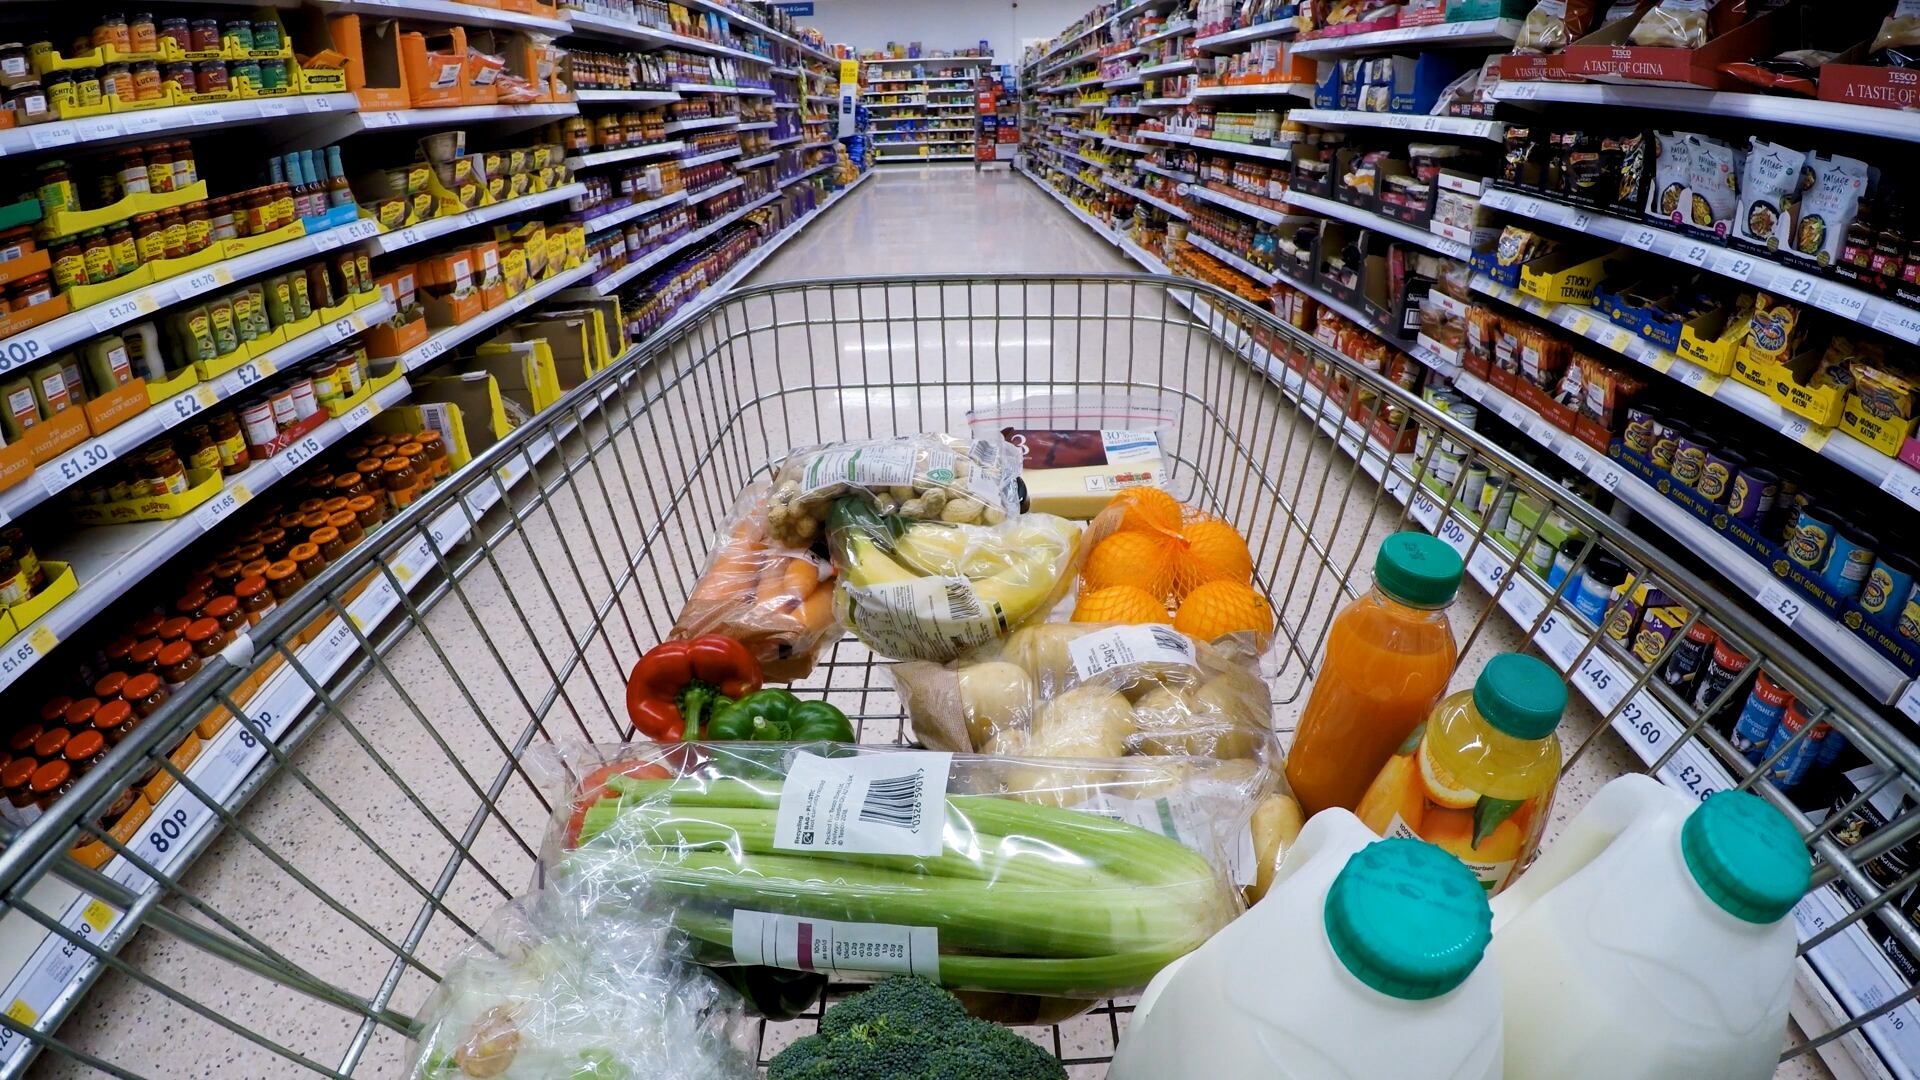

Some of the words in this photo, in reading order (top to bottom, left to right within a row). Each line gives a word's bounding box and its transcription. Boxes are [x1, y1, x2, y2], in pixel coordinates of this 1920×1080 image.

[1612, 49, 1631, 57] TESCO
[1520, 69, 1538, 77] TASTE
[1538, 69, 1548, 77] OF
[1583, 61, 1590, 71] A
[1592, 61, 1617, 72] TASTE
[1618, 62, 1632, 73] OF
[1632, 63, 1664, 76] CHINA
[1889, 72, 1917, 82] TESCO
[1845, 84, 1854, 97] A
[1859, 85, 1896, 101] TASTE
[1897, 88, 1917, 104] OF
[316, 98, 329, 108] £2
[387, 112, 401, 124] £1
[1760, 157, 1784, 173] PASSAGE
[1823, 173, 1849, 186] PASSAGE
[1575, 215, 1588, 227] £1
[349, 222, 376, 238] £1.80
[404, 231, 418, 244] £2
[1638, 232, 1654, 245] £2
[1437, 239, 1459, 253] £1.50
[1689, 246, 1706, 261] £2
[1732, 260, 1751, 275] £2
[191, 274, 215, 289] £1.70
[1790, 279, 1811, 296] £2
[109, 302, 137, 318] £1.70
[1840, 298, 1861, 309] £1.50
[337, 320, 356, 337] £2
[1900, 319, 1920, 332] £1.50
[420, 341, 443, 358] £1.30
[238, 364, 261, 385] £2
[1689, 371, 1702, 382] 70p
[1791, 387, 1813, 402] AROMATIC
[174, 395, 202, 417] £2
[352, 405, 371, 422] £1.65
[1791, 420, 1807, 434] 70p
[286, 438, 320, 464] £1.15
[1011, 434, 1029, 456] 3
[60, 444, 109, 480] £1.30
[1622, 453, 1643, 471] COCONUT
[1642, 465, 1654, 478] MILK
[1603, 471, 1619, 488] £2
[211, 494, 235, 515] £1.65
[1414, 490, 1433, 514] 90p
[1672, 488, 1695, 508] COCONUT
[1694, 501, 1708, 517] MILK
[1442, 520, 1465, 543] 90p
[1730, 524, 1755, 547] COCONUT
[1756, 541, 1772, 558] MILK
[1789, 570, 1803, 585] LIGHT
[1804, 580, 1825, 600] COCONUT
[1824, 594, 1837, 609] MILK
[1778, 599, 1800, 620] £2
[332, 627, 350, 647] £1.85
[1692, 630, 1706, 641] PACK
[1862, 623, 1877, 639] LIGHT
[1878, 635, 1901, 657] COCONUT
[1901, 651, 1914, 667] MILK
[2, 643, 34, 673] £1.65
[1716, 647, 1727, 662] PACK
[1707, 658, 1737, 681] KINGFISH
[1769, 691, 1783, 705] PACK
[1622, 703, 1661, 744] £2.60
[1744, 714, 1769, 733] Coconut
[1750, 727, 1766, 739] Milk
[1679, 766, 1715, 802] £2.6
[122, 810, 145, 839] MEXICO
[150, 808, 188, 853] 80p
[794, 815, 804, 845] Recycling
[62, 922, 92, 958] £320
[1883, 936, 1917, 975] KINGFISHER
